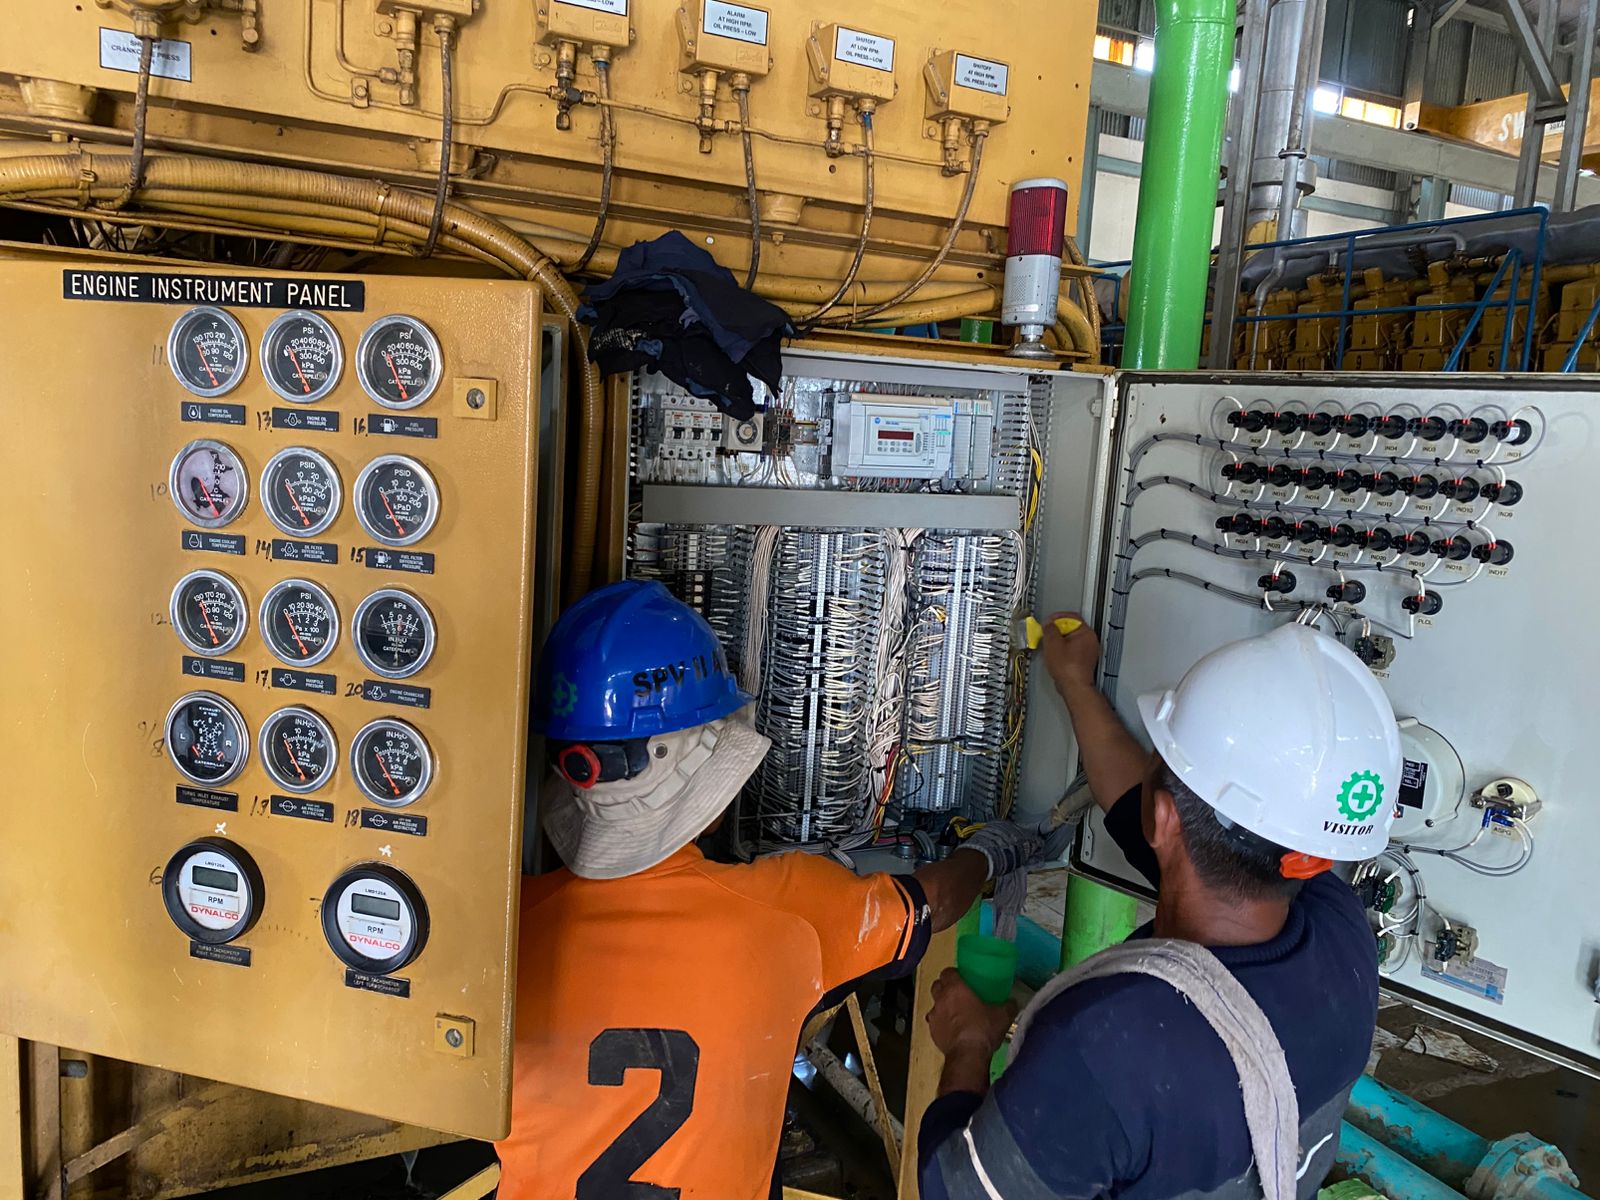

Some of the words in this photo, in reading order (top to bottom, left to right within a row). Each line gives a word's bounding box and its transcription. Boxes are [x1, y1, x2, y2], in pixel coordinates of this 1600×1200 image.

[72, 274, 139, 298] ENGINE
[152, 278, 274, 303] INSTRUMENT
[288, 283, 351, 307] PANEL
[193, 334, 203, 343] 130
[291, 338, 300, 347] 20
[387, 344, 396, 352] 20
[223, 351, 233, 360] 120
[313, 355, 325, 364] 600
[410, 360, 422, 370] 600
[1356, 355, 1362, 369] 9
[1418, 354, 1424, 368] 7
[1487, 354, 1495, 368] 5
[314, 490, 326, 500] 200
[409, 498, 421, 508] 200
[224, 610, 233, 620] 120
[632, 661, 684, 697] SPV
[1323, 821, 1374, 836] VISITOR
[208, 896, 223, 904] RPM
[191, 906, 239, 920] DYNALCO
[368, 926, 383, 934] RPM
[349, 934, 400, 951] DYNALCO
[576, 1028, 700, 1200] 2
